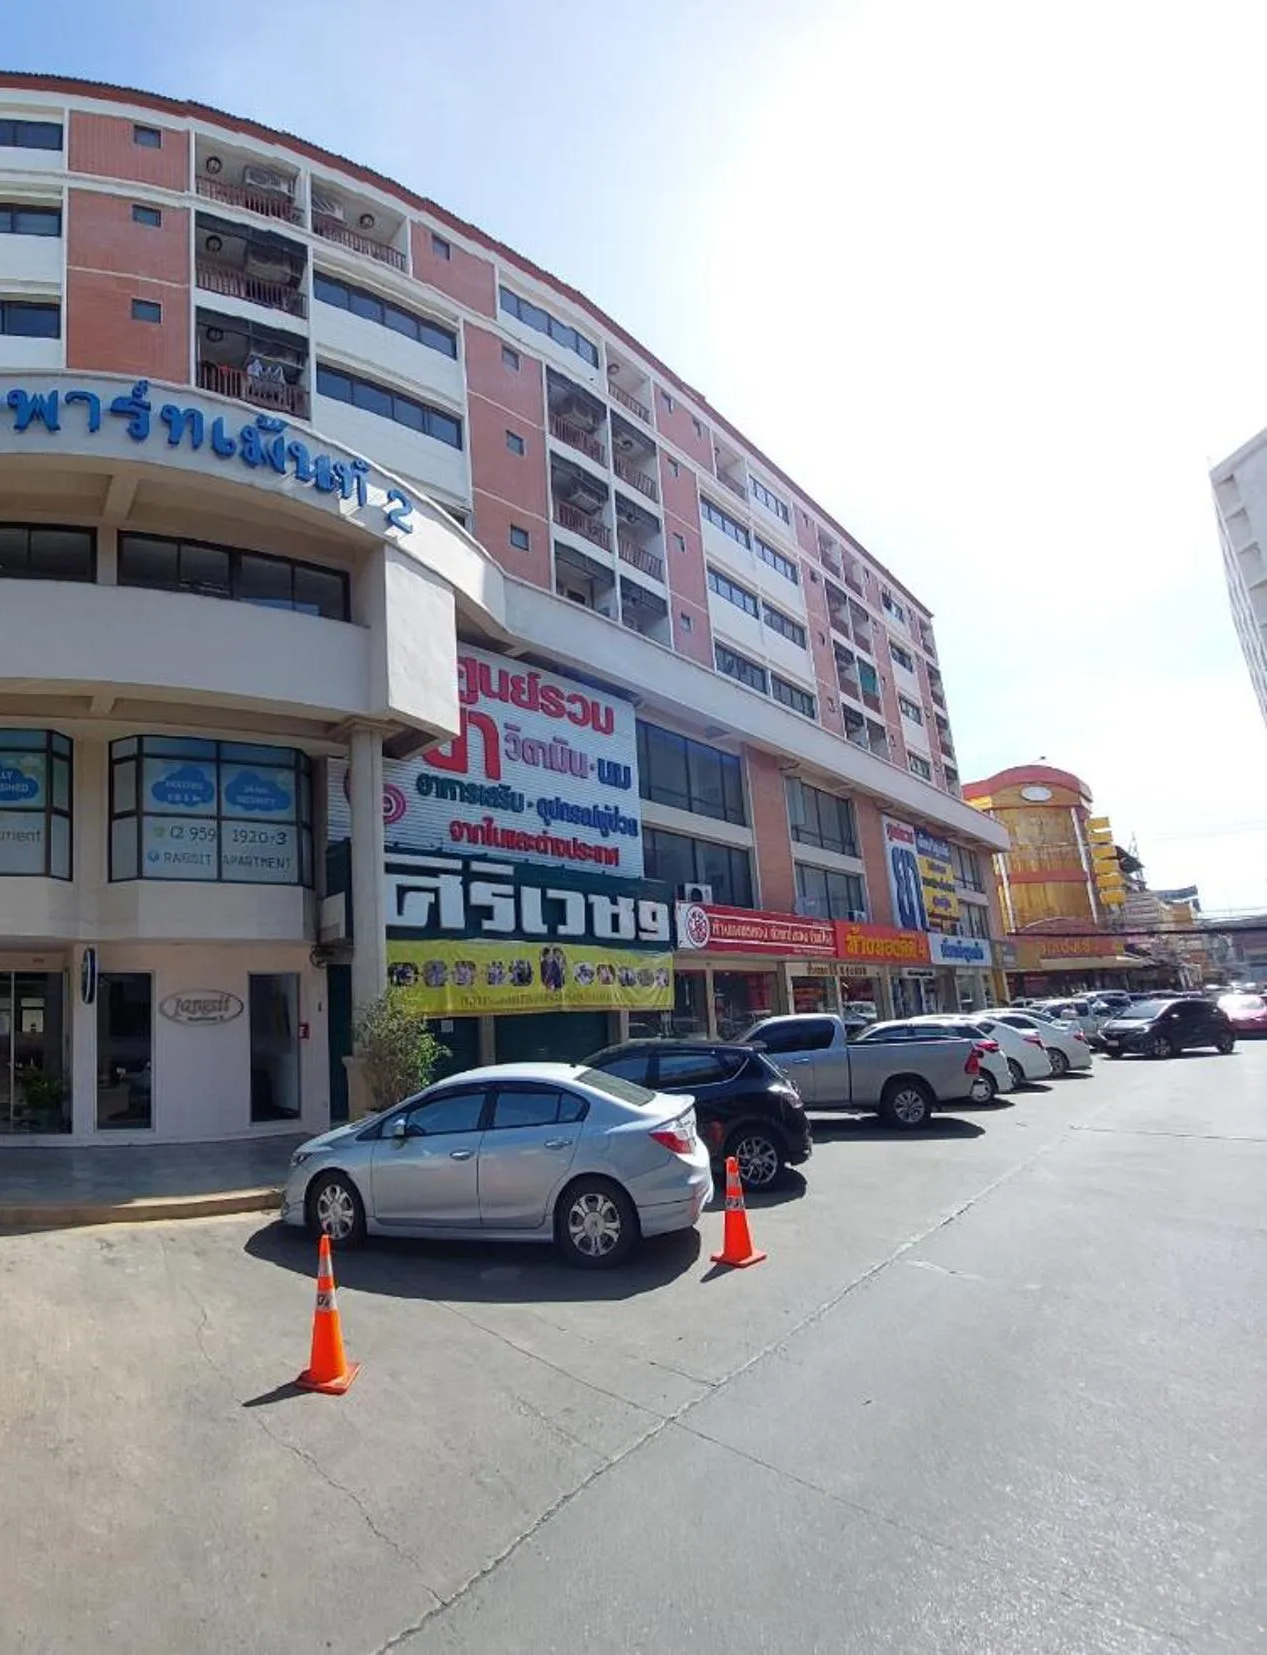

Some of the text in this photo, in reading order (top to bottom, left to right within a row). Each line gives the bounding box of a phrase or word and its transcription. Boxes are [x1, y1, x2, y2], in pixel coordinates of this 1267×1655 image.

[388, 488, 414, 534] 2
[503, 722, 631, 790] วิตามิน นม
